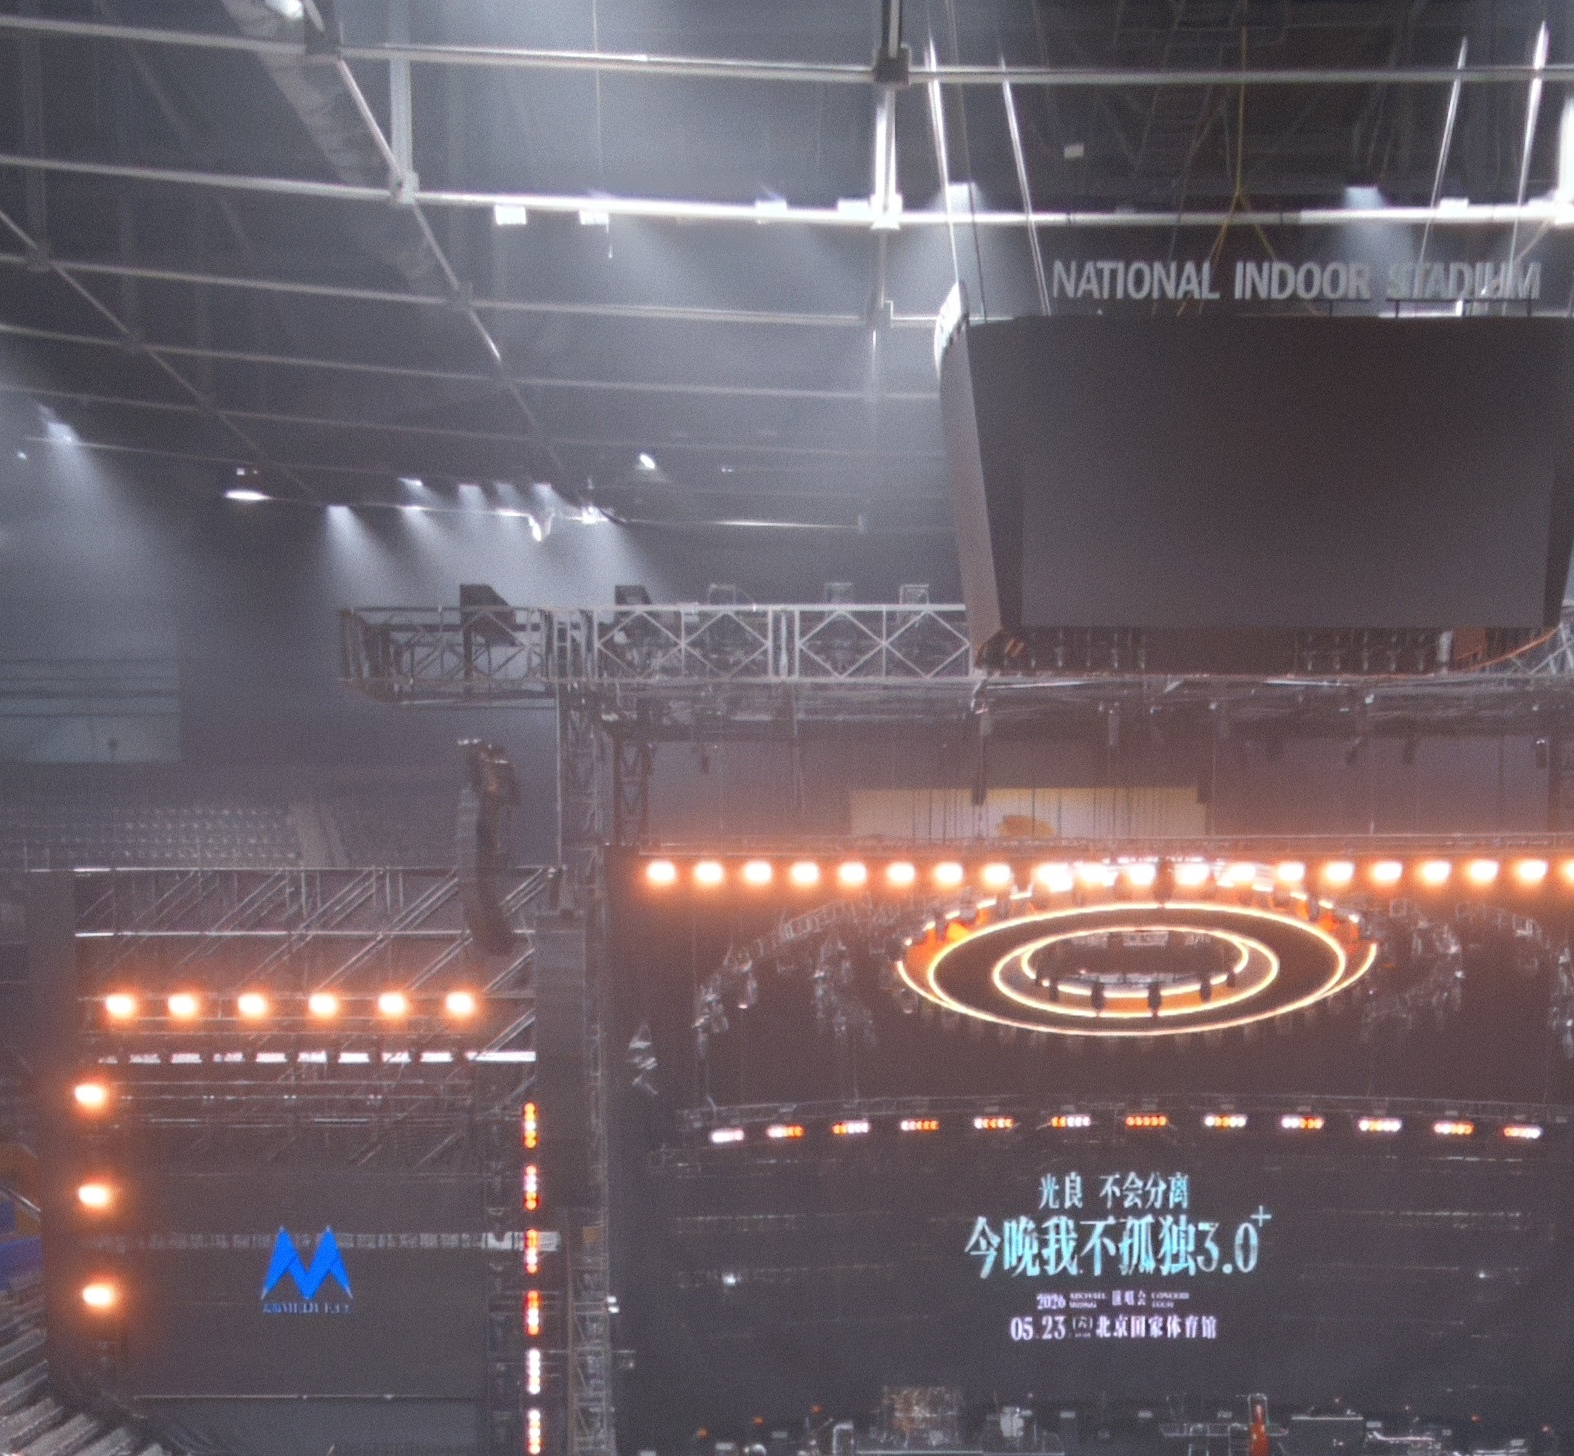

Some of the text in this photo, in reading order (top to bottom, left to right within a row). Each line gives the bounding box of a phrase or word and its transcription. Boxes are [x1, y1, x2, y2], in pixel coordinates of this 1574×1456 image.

[1052, 260, 1541, 299] NATIONAL INDOOR STADIUM
[1039, 1172, 1189, 1209] 光良 不会分离
[1095, 1314, 1217, 1339] 北京国家体育馆
